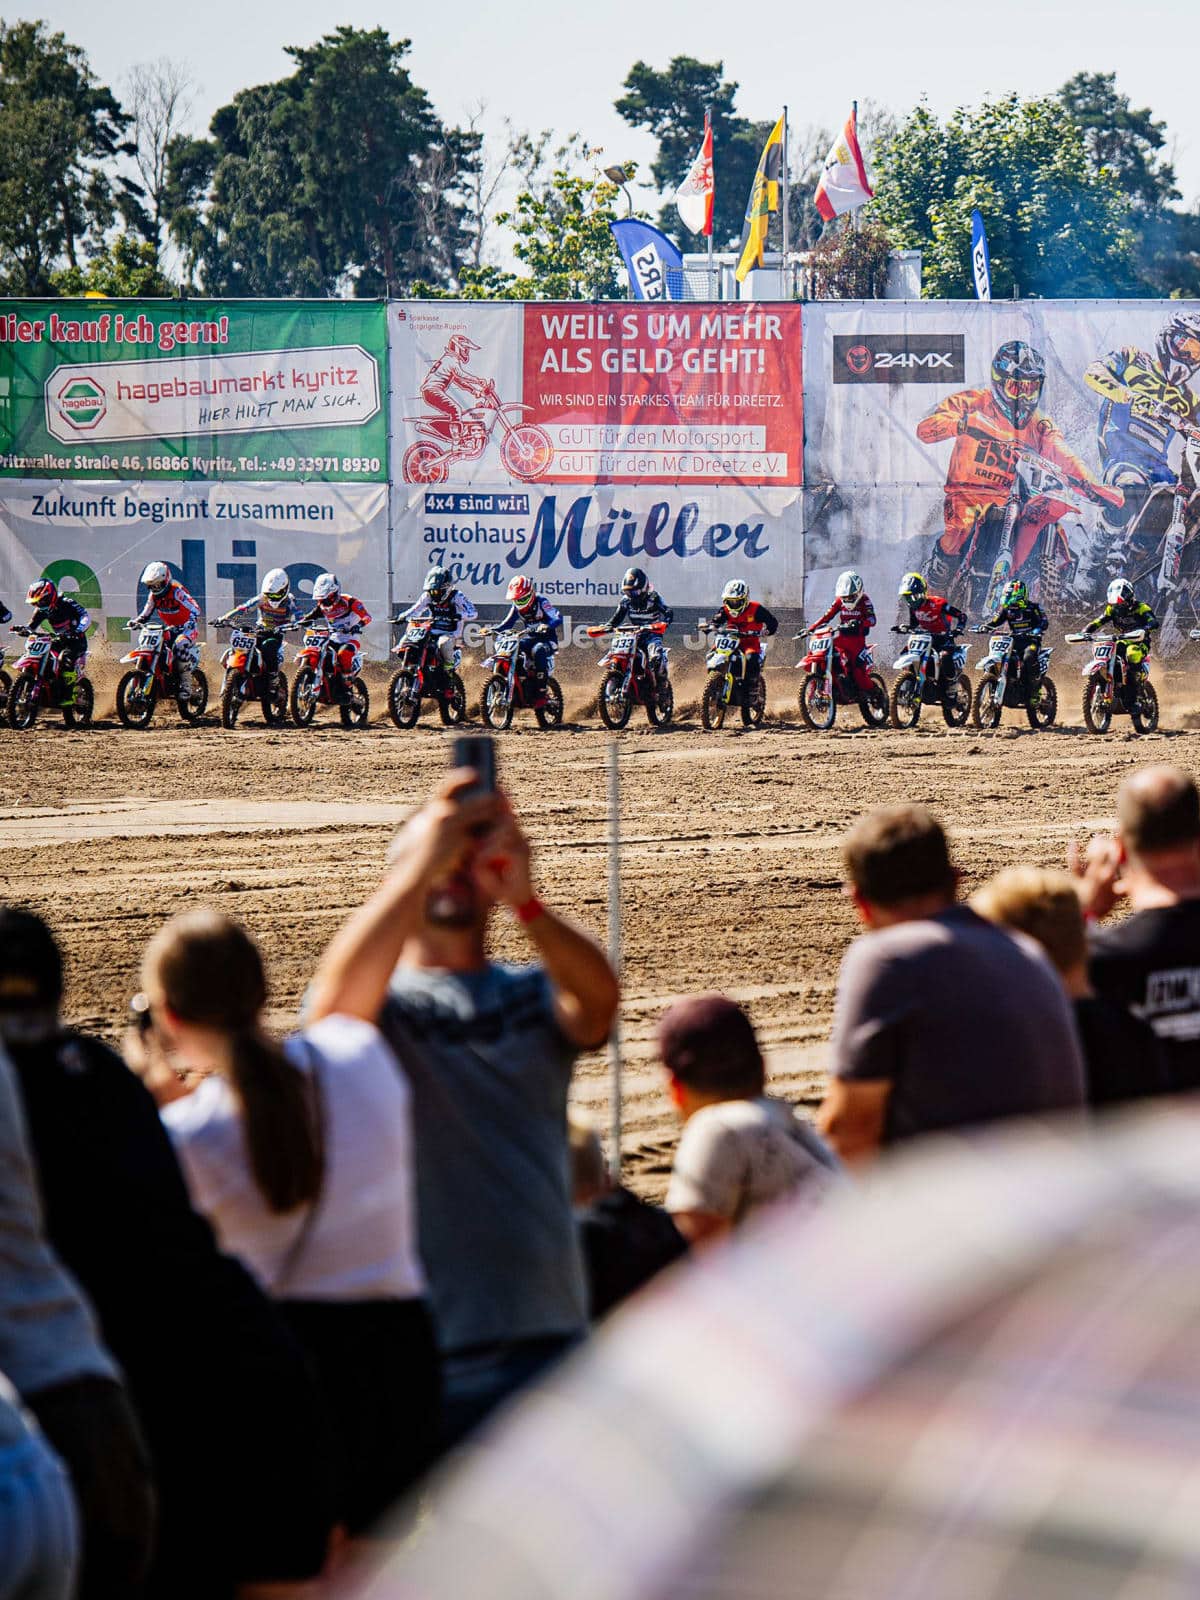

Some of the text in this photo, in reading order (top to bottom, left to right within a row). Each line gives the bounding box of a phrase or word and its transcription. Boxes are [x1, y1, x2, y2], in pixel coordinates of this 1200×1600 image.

[50, 313, 111, 343] kauf
[114, 314, 152, 343] ich
[158, 316, 230, 350] gern!
[647, 315, 691, 341] UM
[700, 315, 783, 341] MEHR
[540, 347, 766, 374] ALS GELD GEHT!
[873, 352, 955, 369] 24MX
[116, 366, 359, 404] hagebaumarkt kyritz
[62, 397, 103, 409] hagebau
[198, 393, 362, 425] HIER HILFT MAN SICH.
[540, 392, 785, 408] WIR SIND EIN STARKES TEAM FÜR DREETZ.
[558, 427, 760, 448] GUT für den Motorsport.
[74, 455, 119, 471] Straße
[121, 456, 145, 473] 46,
[146, 456, 190, 471] 16866
[192, 456, 238, 474] Kyritz,
[238, 456, 267, 472] Tel.:
[269, 457, 296, 472] +49
[300, 457, 342, 473] 33971
[342, 457, 381, 473] 8930
[558, 455, 781, 473] GUT für den MC Dreetz e.V.
[31, 495, 335, 523] Zukunft beginnt zusammen
[426, 495, 528, 511] 4x4 sind wir!
[423, 521, 526, 544] autohaus
[505, 494, 770, 570] Müller
[715, 638, 738, 650] 194
